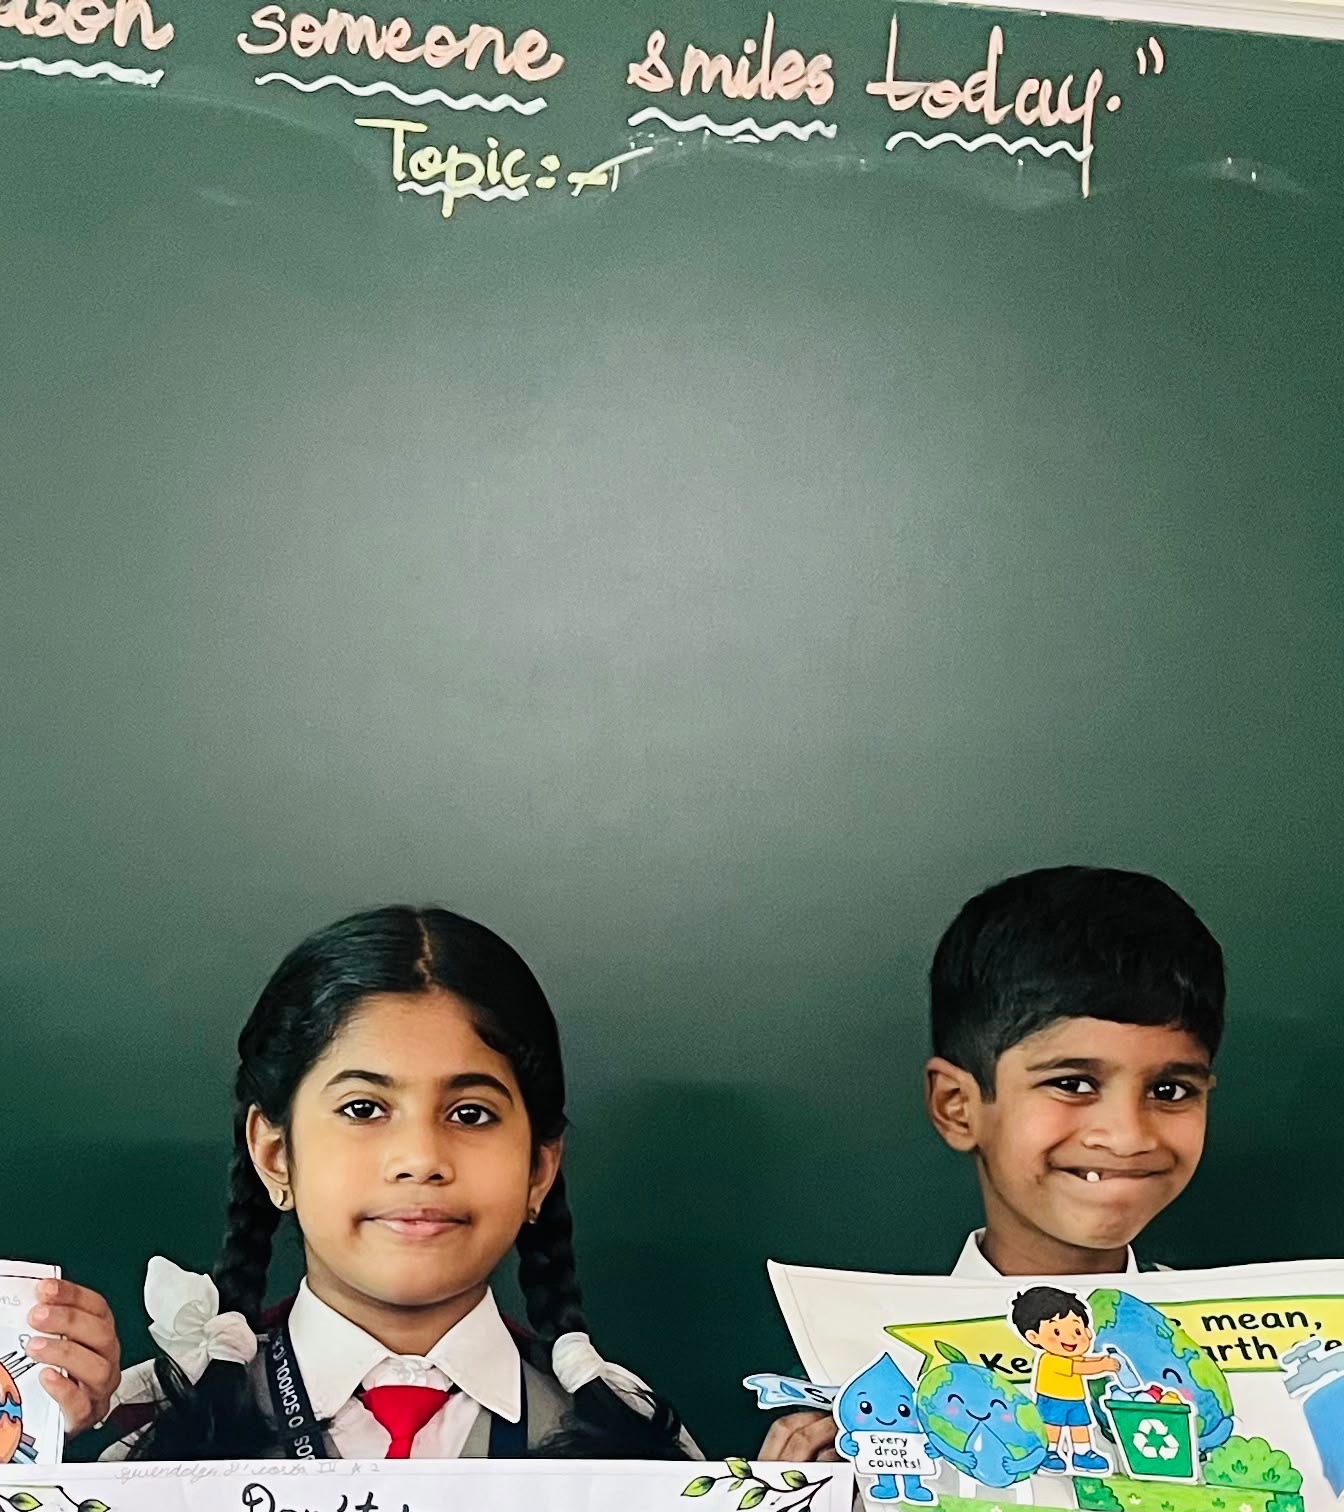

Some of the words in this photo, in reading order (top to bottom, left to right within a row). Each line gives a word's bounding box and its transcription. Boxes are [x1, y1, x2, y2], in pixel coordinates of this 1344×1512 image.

[238, 6, 564, 82] someone
[627, 12, 836, 106] smiles
[1202, 1311, 1322, 1331] mean,
[871, 1434, 908, 1448] Every
[875, 1447, 907, 1458] drop
[868, 1457, 922, 1470] counts!
